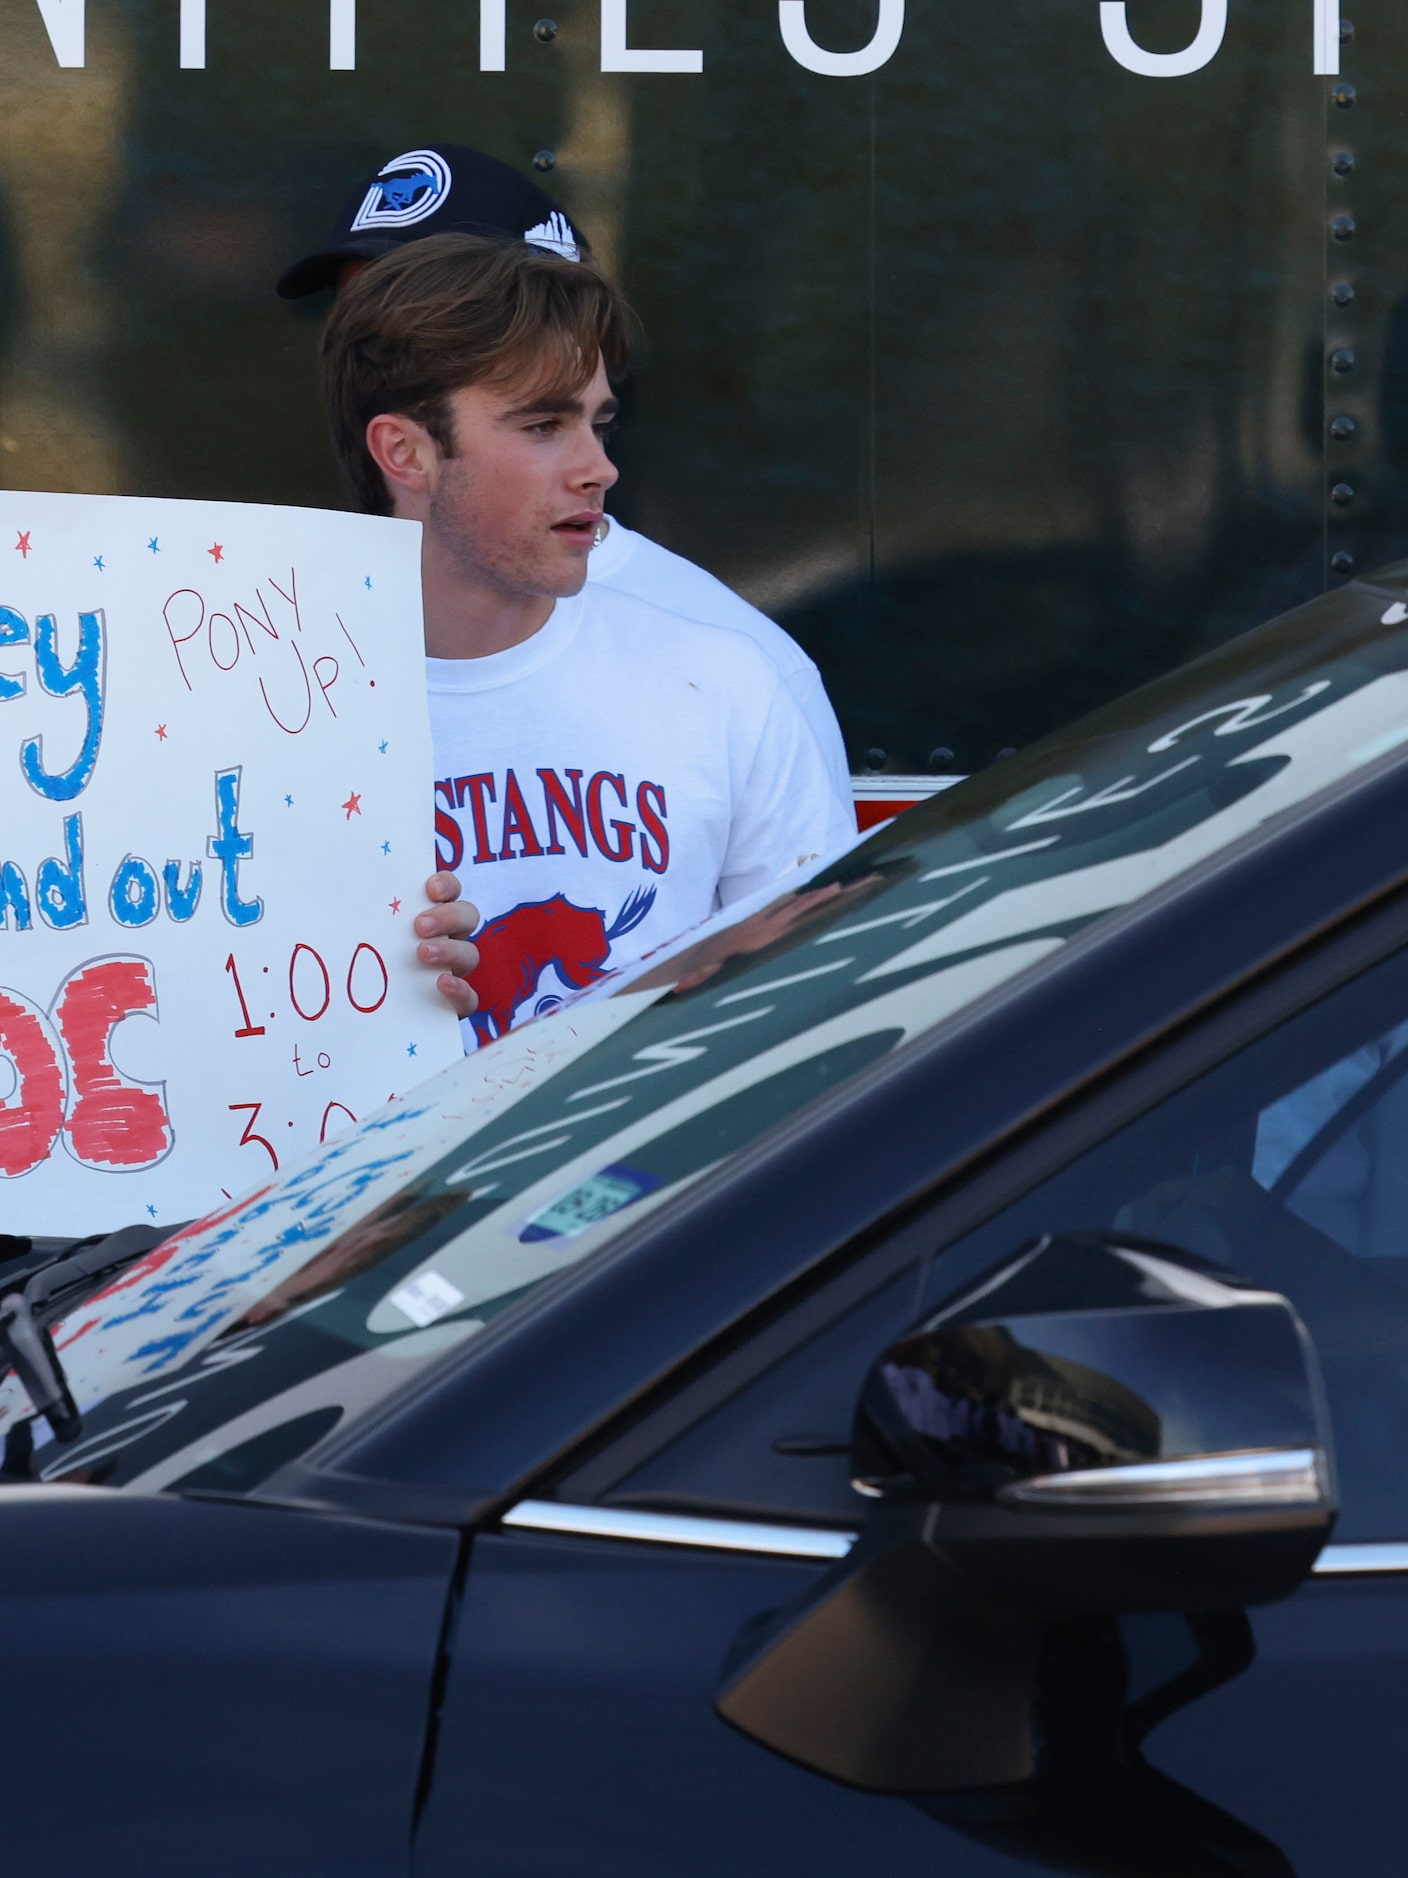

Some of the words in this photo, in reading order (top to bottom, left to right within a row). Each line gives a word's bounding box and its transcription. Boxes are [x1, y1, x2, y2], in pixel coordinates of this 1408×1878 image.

[163, 566, 302, 692] PONY
[224, 942, 389, 1038] 1:00
[292, 1043, 331, 1077] to
